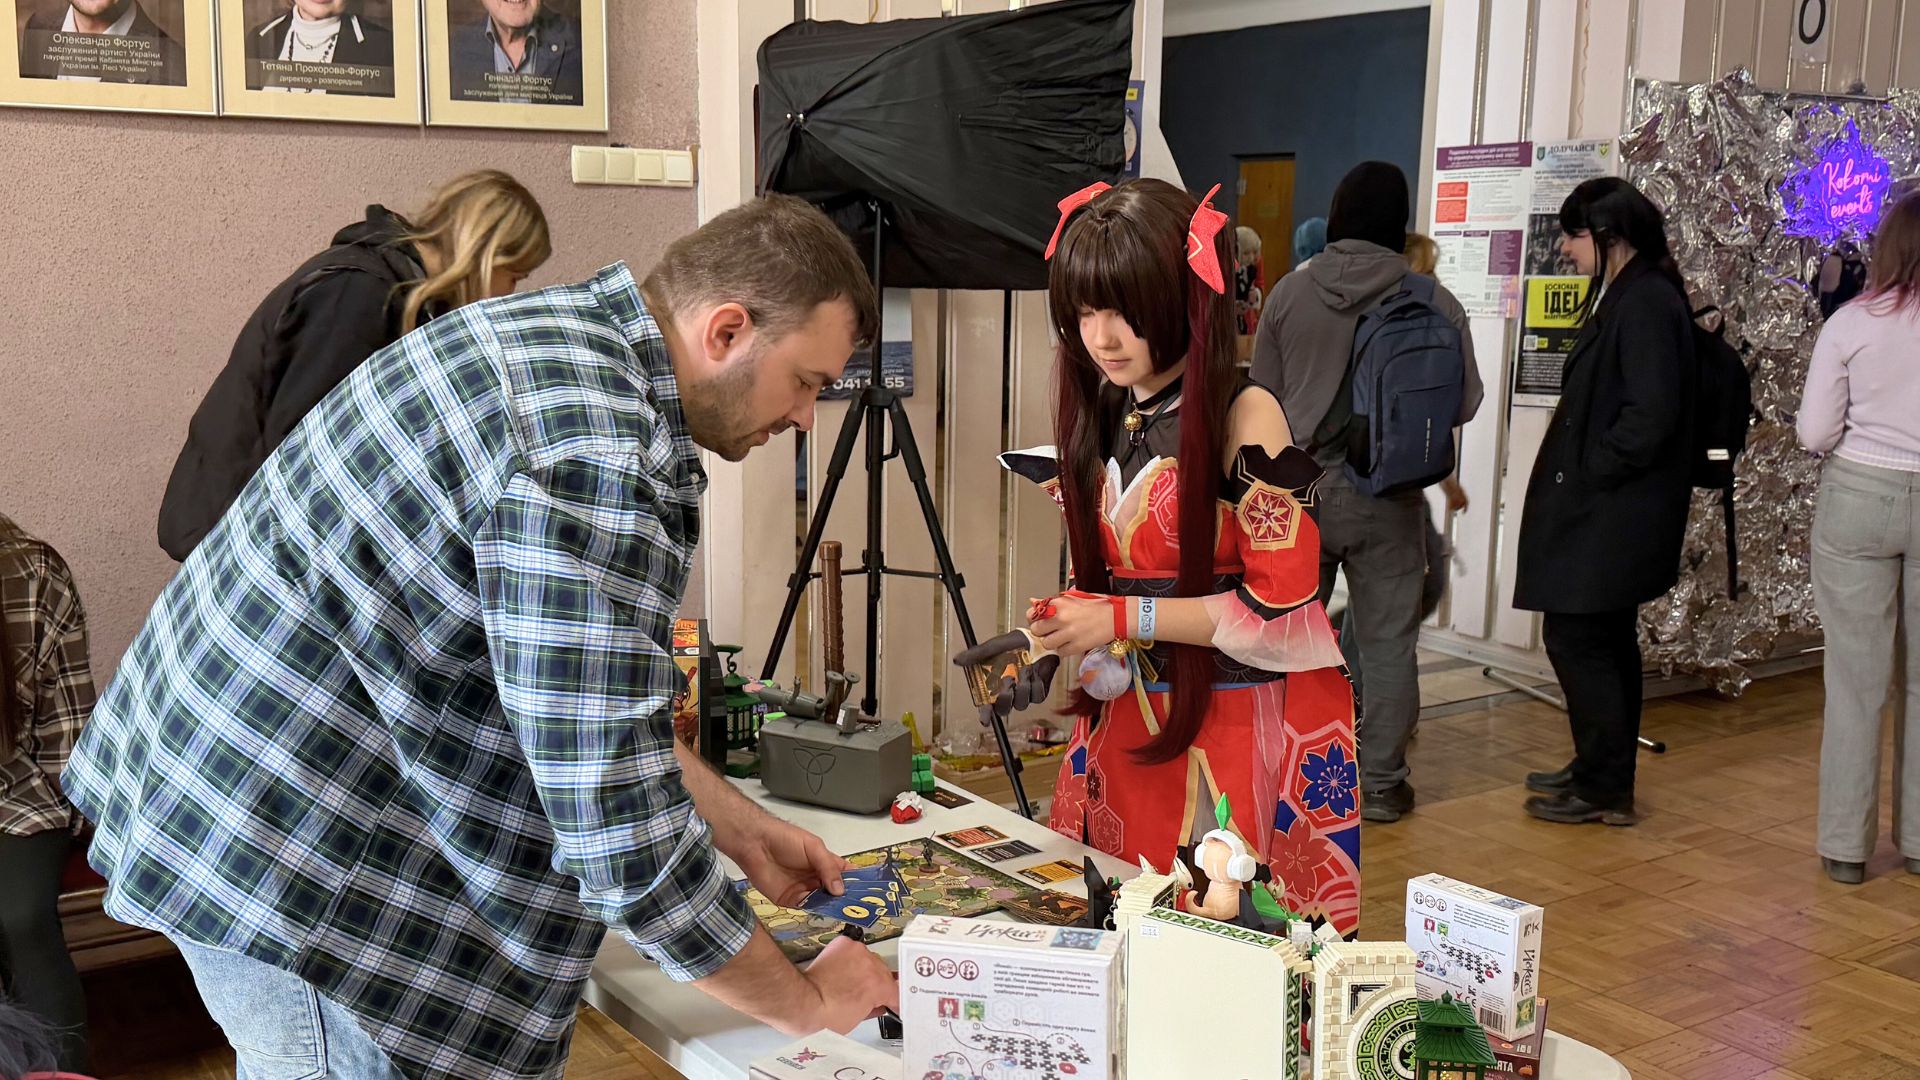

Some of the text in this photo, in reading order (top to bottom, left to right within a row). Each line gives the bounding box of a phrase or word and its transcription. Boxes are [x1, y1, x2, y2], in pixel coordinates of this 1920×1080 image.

[53, 33, 150, 49] Олександр Фортус
[260, 61, 380, 78] Тетяна Прохорова-Фортус
[484, 72, 552, 85] Геннадій Фортус
[1824, 159, 1881, 197] Kokomi
[1831, 185, 1873, 218] events
